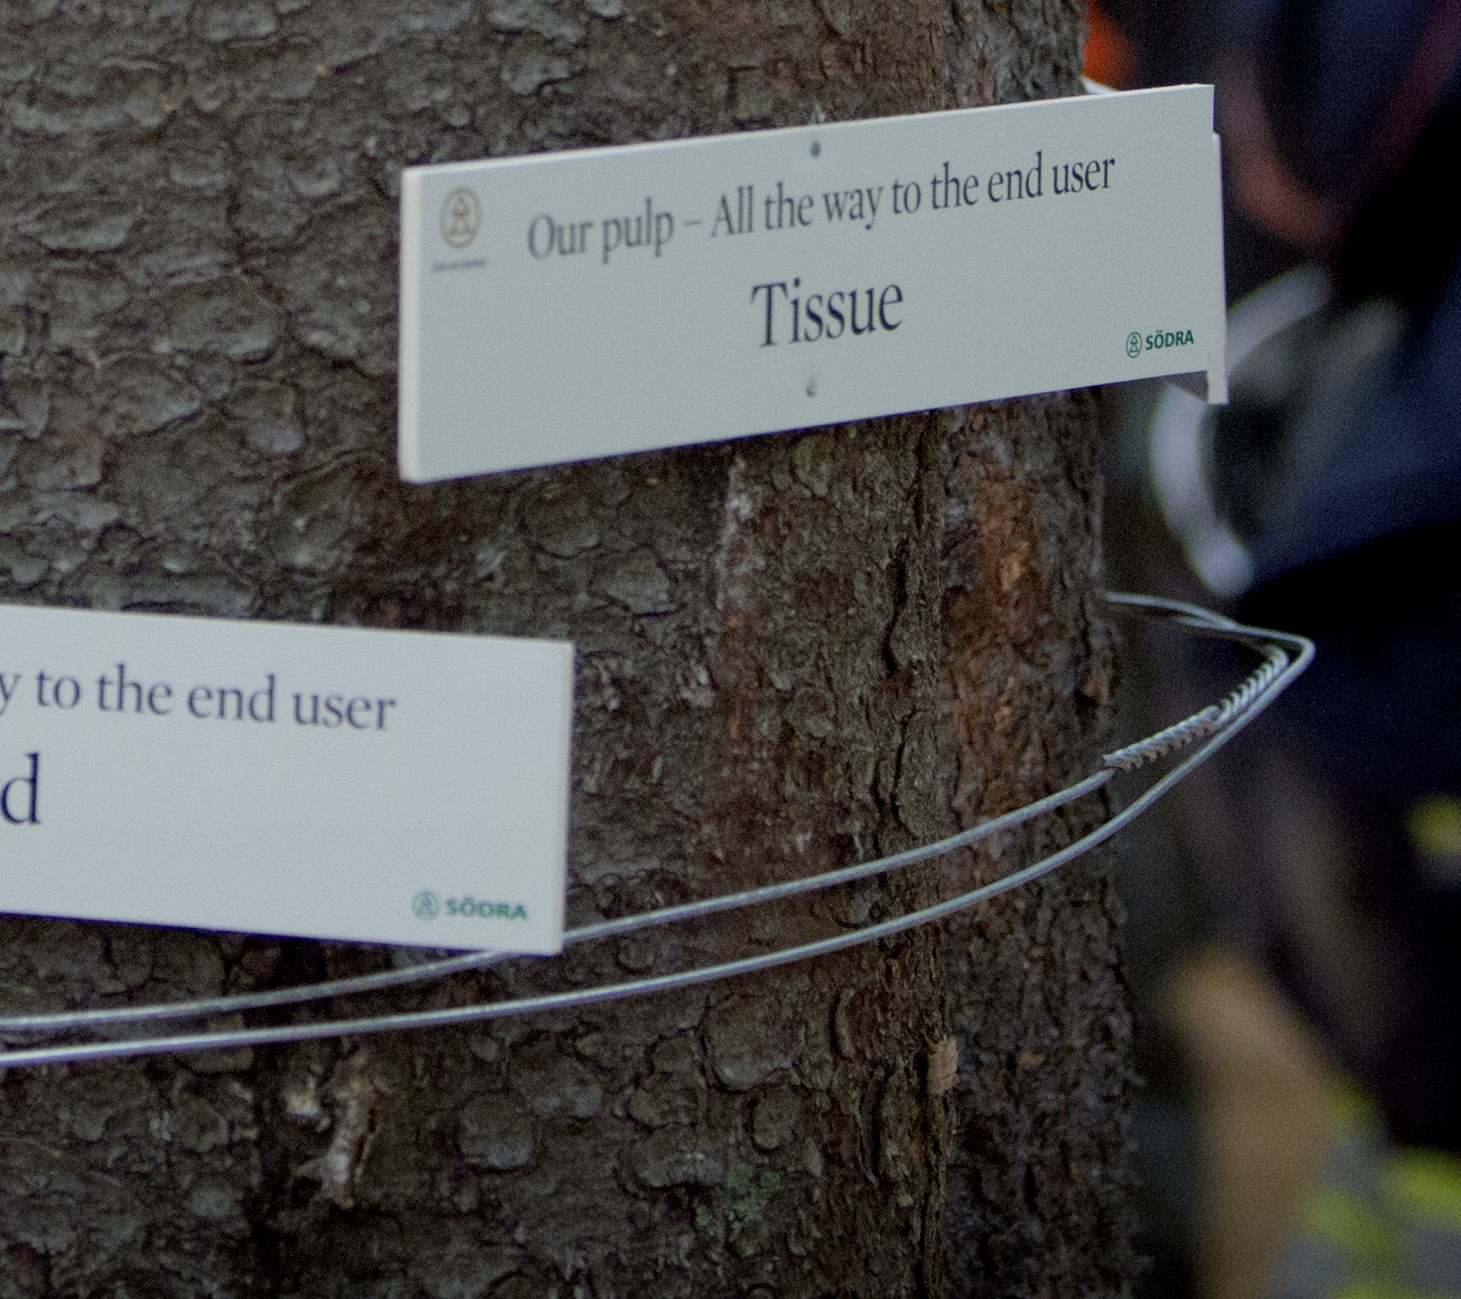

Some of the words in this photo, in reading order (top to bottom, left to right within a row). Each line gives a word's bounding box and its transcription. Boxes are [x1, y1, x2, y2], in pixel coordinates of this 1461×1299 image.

[526, 214, 595, 260] Our
[601, 196, 675, 265] pulp
[711, 184, 754, 238] All
[763, 180, 815, 231] the
[821, 186, 884, 231] way
[891, 180, 923, 215] to
[930, 161, 980, 211] the
[987, 149, 1044, 204] end
[1052, 157, 1116, 196] user
[751, 277, 904, 347] Tissue
[1145, 329, 1195, 351] SÖDRA
[35, 670, 82, 708] to
[96, 662, 174, 716] the
[186, 672, 277, 723] end
[292, 692, 397, 731] user
[445, 895, 529, 921] SÖDRA
